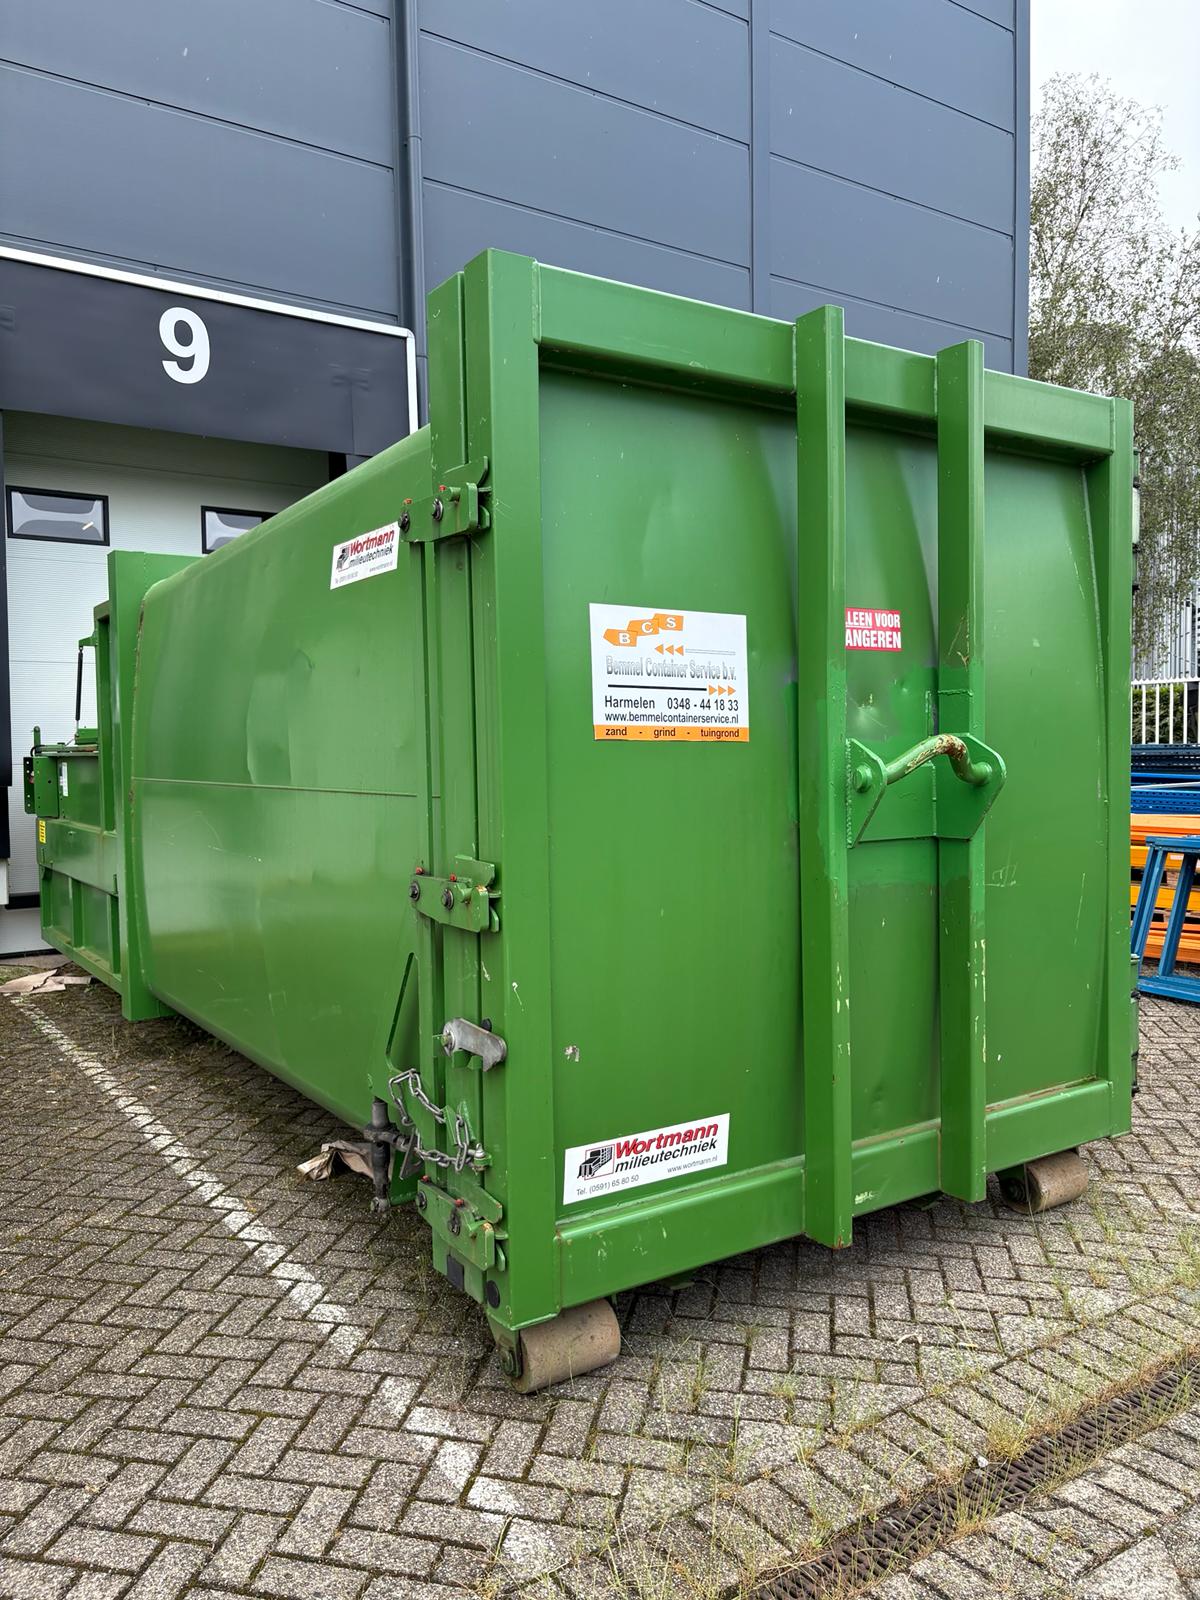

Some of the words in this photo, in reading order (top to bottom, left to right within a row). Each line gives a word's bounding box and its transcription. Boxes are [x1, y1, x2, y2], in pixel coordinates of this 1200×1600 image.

[159, 307, 210, 384] 9
[350, 530, 394, 556] Wortmann
[846, 611, 872, 627] LEEN
[875, 613, 900, 628] VOOR
[846, 629, 901, 648] ANGEREN
[606, 656, 643, 676] Bemmel
[646, 658, 688, 678] Container
[689, 660, 720, 679] Service
[723, 663, 736, 680] b.v.
[605, 696, 655, 708] Harmelen
[667, 698, 690, 709] 0348
[700, 699, 711, 710] 44
[715, 699, 725, 710] 18
[728, 700, 738, 711] 33
[605, 712, 738, 724] www.bemmelcontainerservice.nl
[606, 727, 627, 735] zand
[654, 728, 676, 738] grind
[701, 729, 739, 739] tuingrond
[616, 1123, 718, 1159] Wortmann
[615, 1138, 717, 1173] milieutechniek
[667, 1155, 718, 1174] www.wortmann.nl
[576, 1187, 587, 1196] Tel.
[589, 1182, 610, 1194] (0591)
[612, 1178, 620, 1186] 65
[621, 1176, 629, 1185] 80
[631, 1174, 639, 1182] 50
